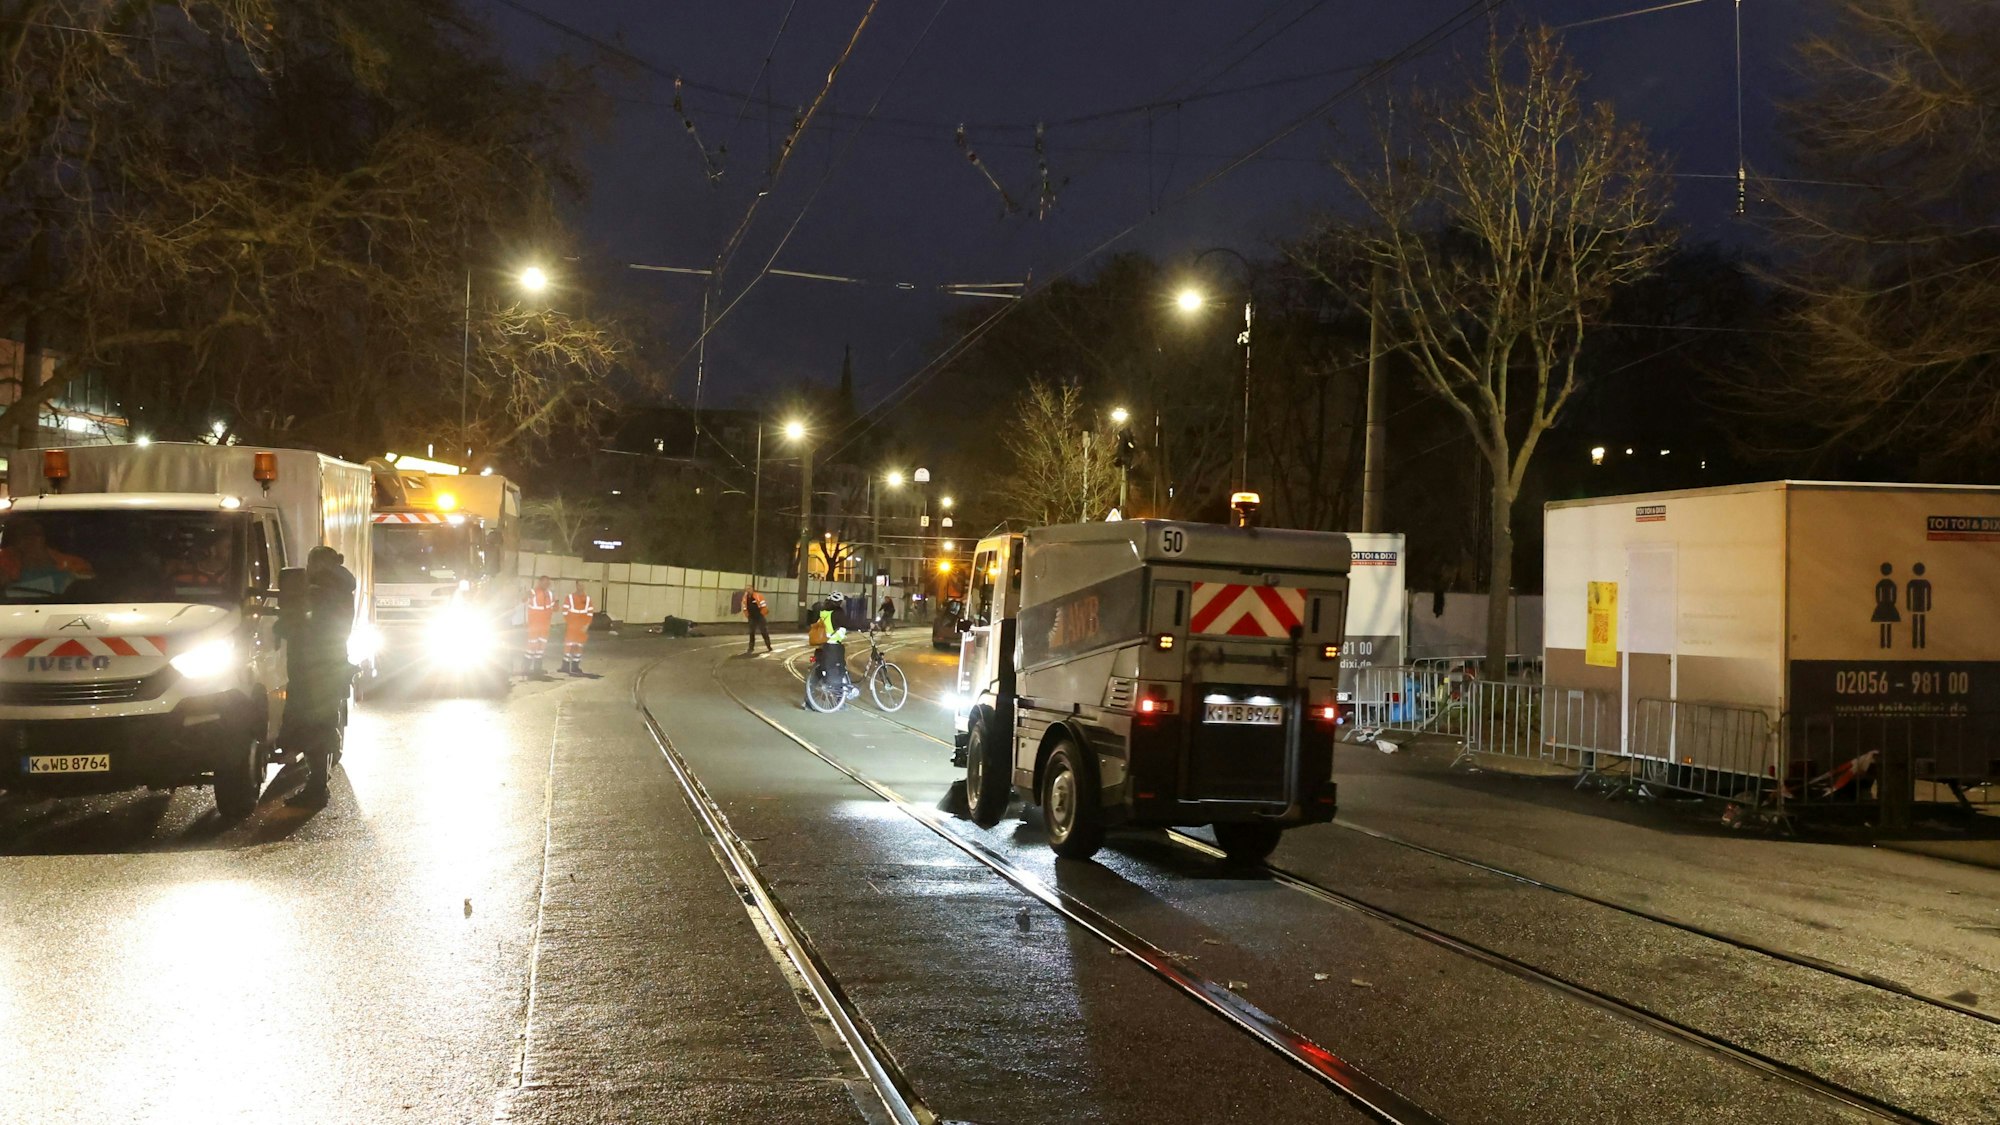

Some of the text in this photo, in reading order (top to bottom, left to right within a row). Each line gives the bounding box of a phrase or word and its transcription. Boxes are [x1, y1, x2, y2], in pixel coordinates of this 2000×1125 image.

[1929, 518, 2000, 531] TOI TOI & DIX
[1164, 531, 1182, 552] 50
[1351, 552, 1396, 560] OI TOI & DIXI
[1337, 641, 1372, 655] 81 00
[28, 655, 110, 672] IVECO
[1836, 671, 1889, 694] 02056
[1911, 671, 1940, 694] 981
[1948, 671, 1969, 694] 00
[72, 757, 107, 770] 8764
